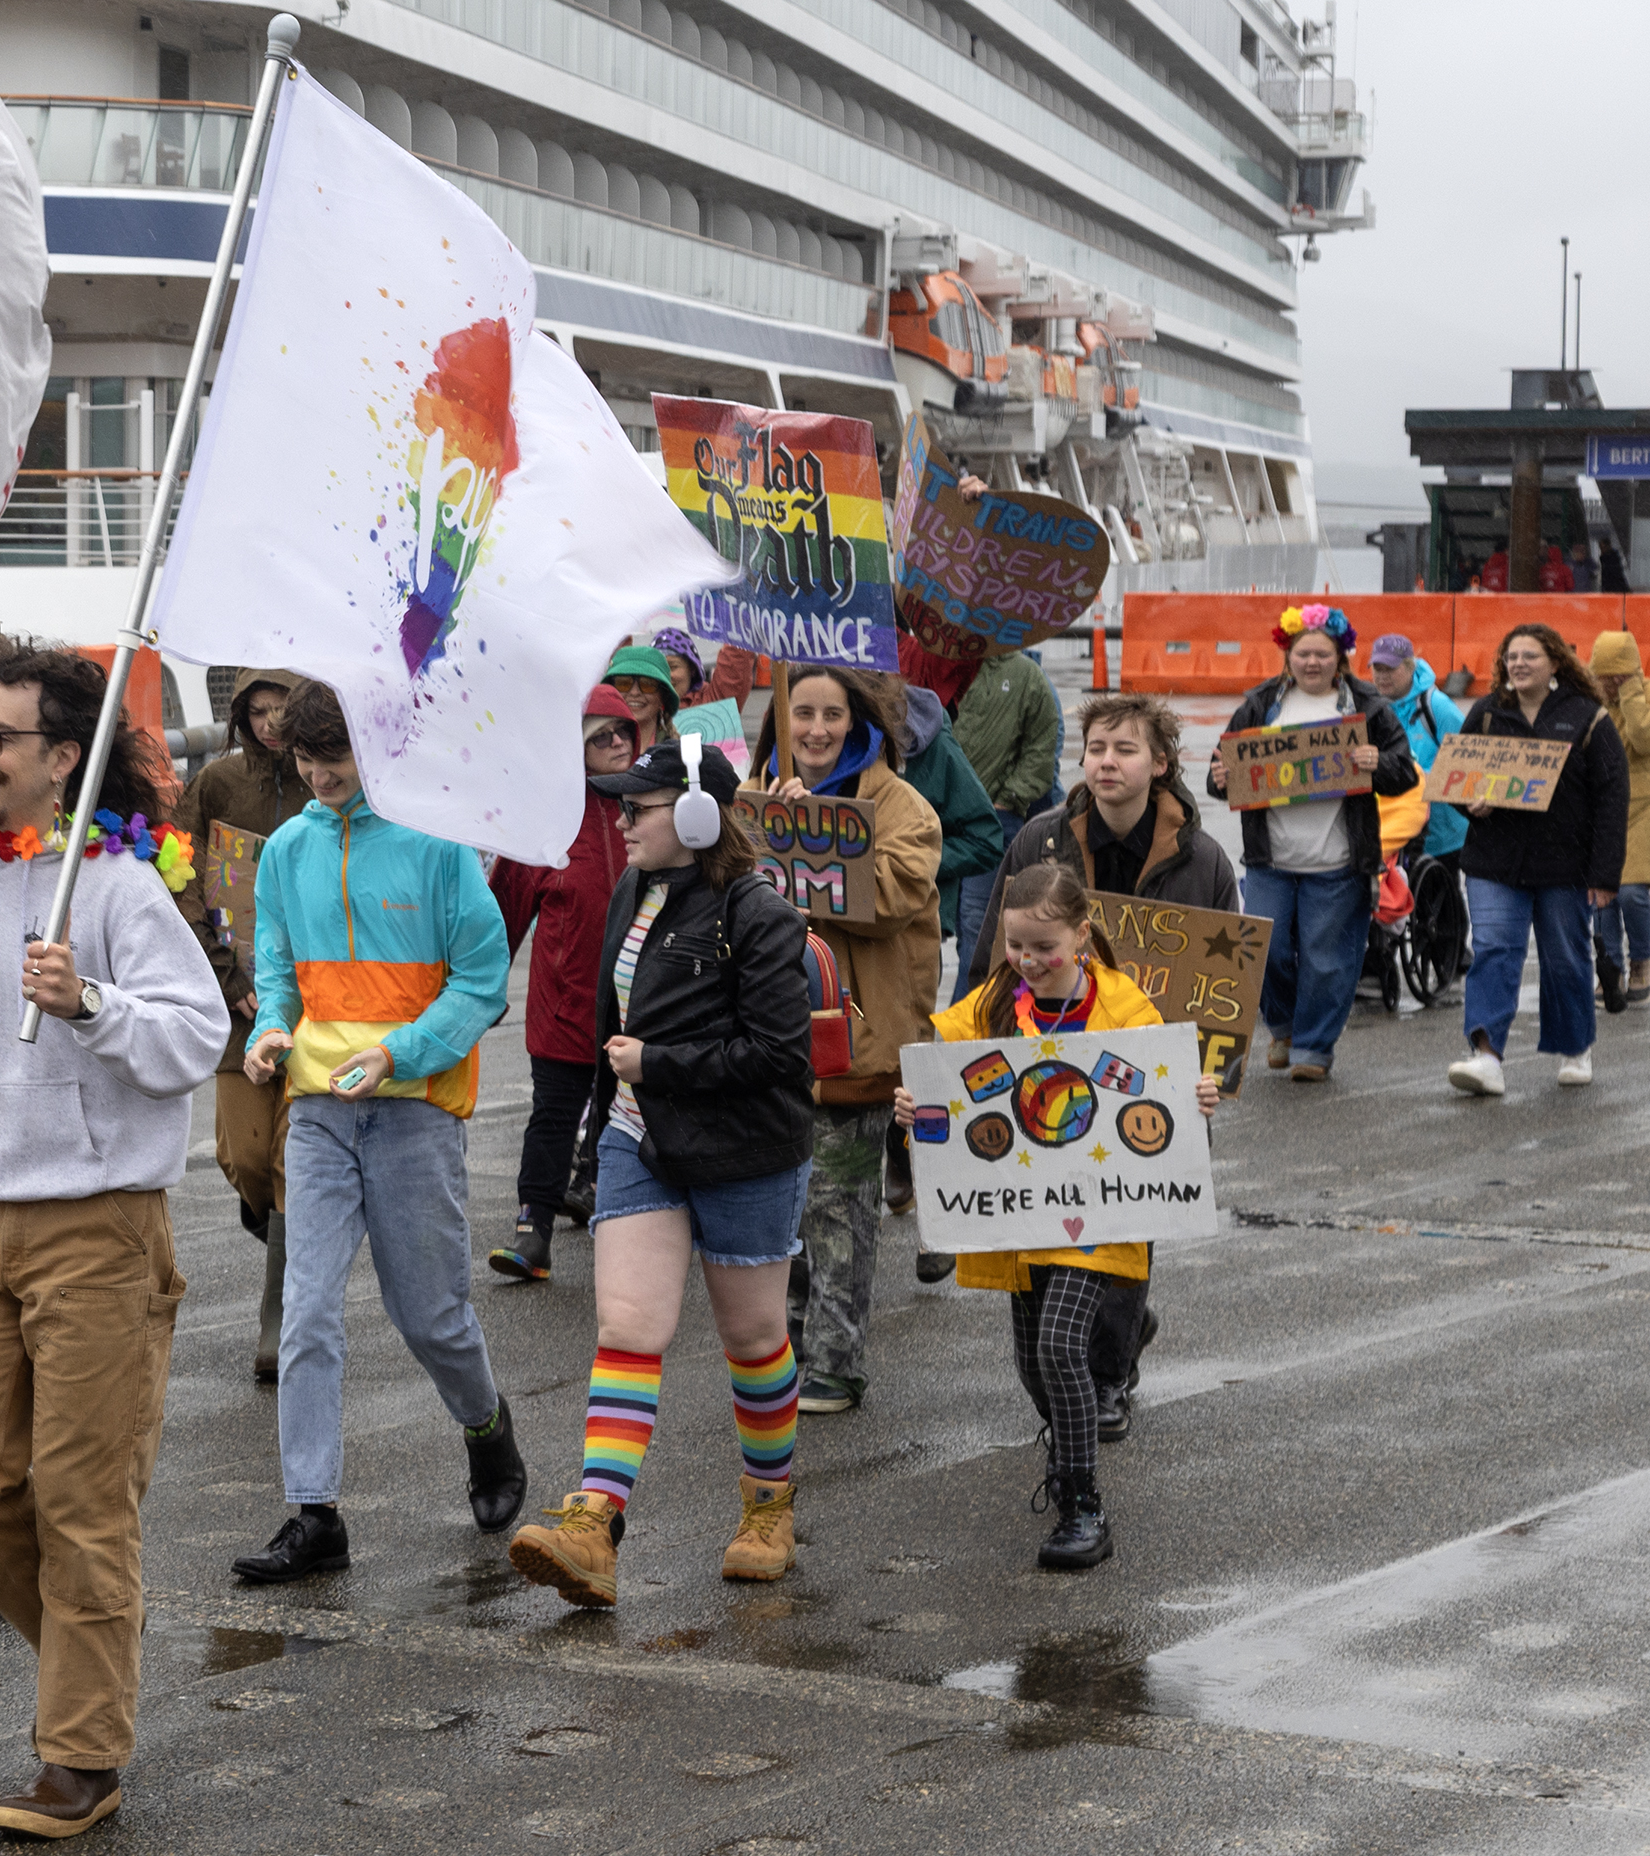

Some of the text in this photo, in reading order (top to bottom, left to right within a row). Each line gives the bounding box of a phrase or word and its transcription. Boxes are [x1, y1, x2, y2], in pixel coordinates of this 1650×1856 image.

[694, 422, 826, 513] Our Flag
[906, 414, 1099, 552] LET TRANS
[737, 495, 789, 526] means
[902, 461, 1090, 588] CHILDREN
[895, 550, 1033, 645] OPPOSE
[945, 563, 1084, 627] SPORTS
[683, 588, 875, 663] TO IGNORANCE
[1237, 726, 1359, 761] PRIDE WAS A
[1451, 748, 1562, 770] FROM NEW YORK
[1442, 769, 1547, 803] PRIDE
[732, 800, 872, 860] ROUD
[757, 855, 848, 915] OM
[1087, 899, 1190, 957] ANS
[1184, 971, 1243, 1022] IS
[936, 1174, 1202, 1217] WE'RE ALL HUMAN
